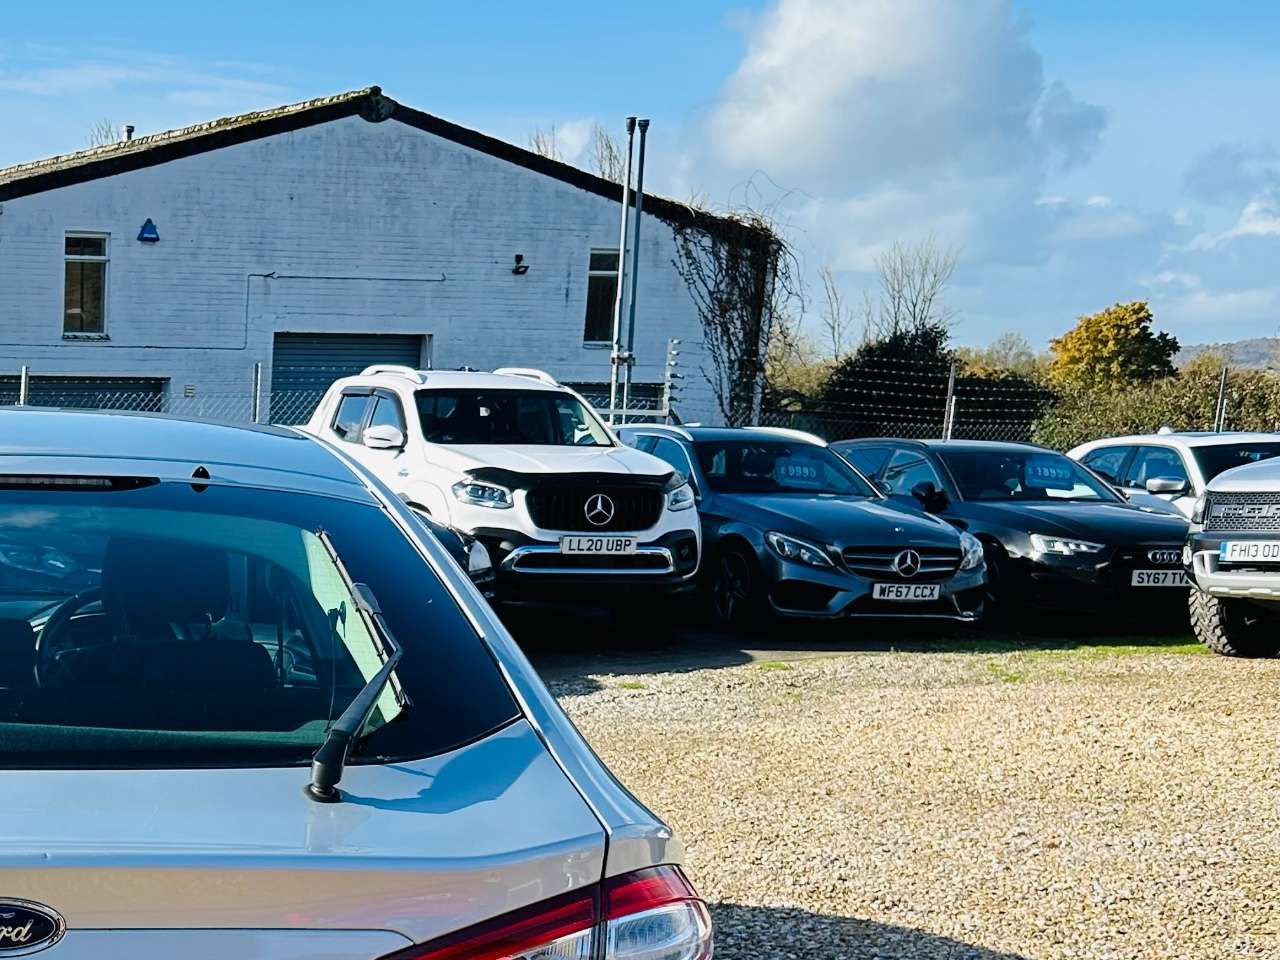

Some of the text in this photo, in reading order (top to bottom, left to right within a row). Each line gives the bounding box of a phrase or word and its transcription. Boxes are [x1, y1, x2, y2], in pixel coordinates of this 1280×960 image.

[568, 538, 632, 551] LL20 UBP
[1230, 544, 1280, 558] FH13 OD
[1136, 572, 1189, 584] SY67 TV
[879, 585, 936, 599] WF67 CCX
